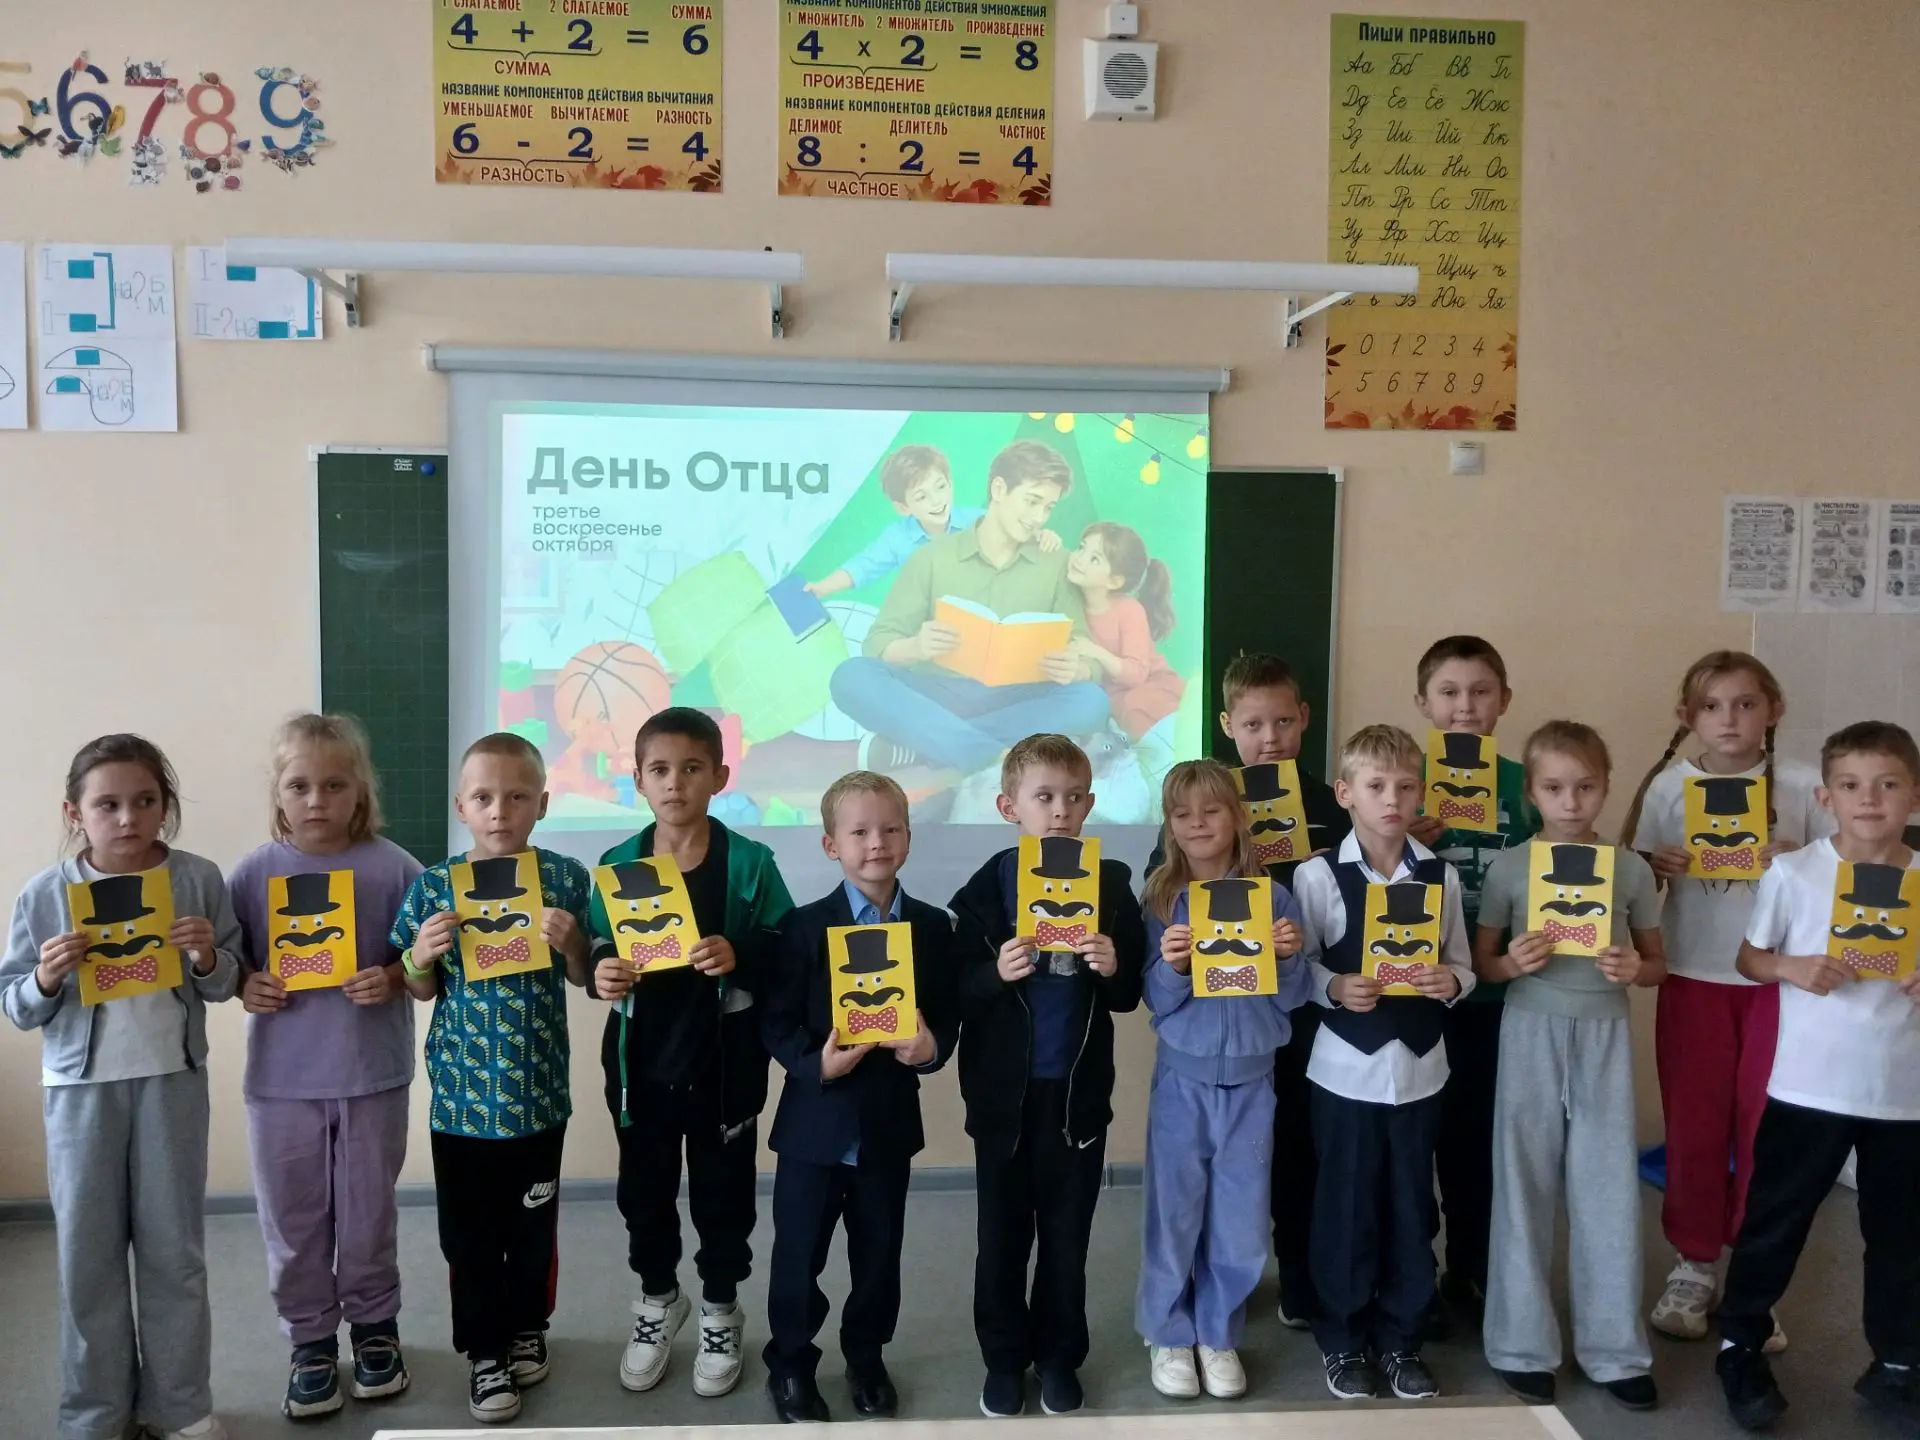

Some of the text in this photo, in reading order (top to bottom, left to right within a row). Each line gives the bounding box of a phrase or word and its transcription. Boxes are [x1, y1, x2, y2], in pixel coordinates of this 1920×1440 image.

[563, 0, 630, 16] СЛАГАЕМОЕ
[672, 5, 713, 20] СУММА
[924, 0, 978, 14] ДЕЙСТВИЯ
[981, 5, 1047, 17] УМНОЖЕНИЯ
[451, 13, 478, 45] 4
[567, 19, 593, 51] 2
[683, 24, 709, 55] 6
[787, 12, 1045, 37] 1 МНОЖИТЕЛЬ 2 МНОЖИТЕЛЬ ПРОИЗВЕДЕНИЕ
[1359, 22, 1403, 42] Пиши
[797, 30, 823, 60] 4
[900, 35, 925, 66] 2
[1015, 40, 1039, 71] 8
[494, 60, 551, 76] СУММА
[1344, 51, 1512, 79] Аа Бб Вв Гг
[442, 83, 714, 105] НАЗВАНИЕ КОМПОНЕНТОВ ДЕЙСТВИЯ ВЫЧИТАНИЯ
[803, 73, 925, 93] ПРОИЗВЕДЕНИЕ
[57, 62, 113, 144] 6
[183, 82, 237, 160] 8
[259, 79, 314, 156] 9
[785, 97, 1045, 120] НАЗВАНИЕ КОМПОНЕНТОВ ДЕЙСТВИЯ ДЕЛЕНИЯ
[1342, 85, 1370, 116] Дд
[1387, 86, 1407, 109] Ее
[1461, 89, 1510, 112] Жж
[443, 102, 712, 125] УМЕНЬШАЕМОЕ ВЫЧИТАЕМОЕ РАЗНОСТЬ
[789, 117, 1046, 140] ДЕЛИМОЕ ДЕЛИТЕЛЬ ЧАСТНОЕ
[1342, 117, 1510, 149] Зз Ии Йй Кк
[452, 123, 480, 153] 6
[567, 127, 593, 158] 2
[682, 131, 709, 161] 4
[797, 136, 822, 167] 8
[899, 140, 924, 171] 2
[1012, 146, 1038, 176] 4
[1340, 152, 1509, 178] Лл Мм Нн Оо
[481, 166, 565, 183] РАЗНОСТЬ
[827, 180, 899, 197] ЧАСТНОЕ
[1341, 184, 1509, 217] Пп Рр Сс Тт
[1341, 217, 1508, 249] Уу Фф Хх Цц
[1437, 253, 1477, 281] Щщ
[1431, 286, 1465, 308] Юю
[1479, 287, 1507, 310] Яя
[1360, 333, 1484, 357] 0 1 2 3 4
[1356, 371, 1484, 394] 5 6 7 8 9
[527, 447, 830, 500] День Отца
[532, 505, 601, 521] третье
[532, 522, 663, 540] воскресенье
[532, 537, 614, 555] октября
